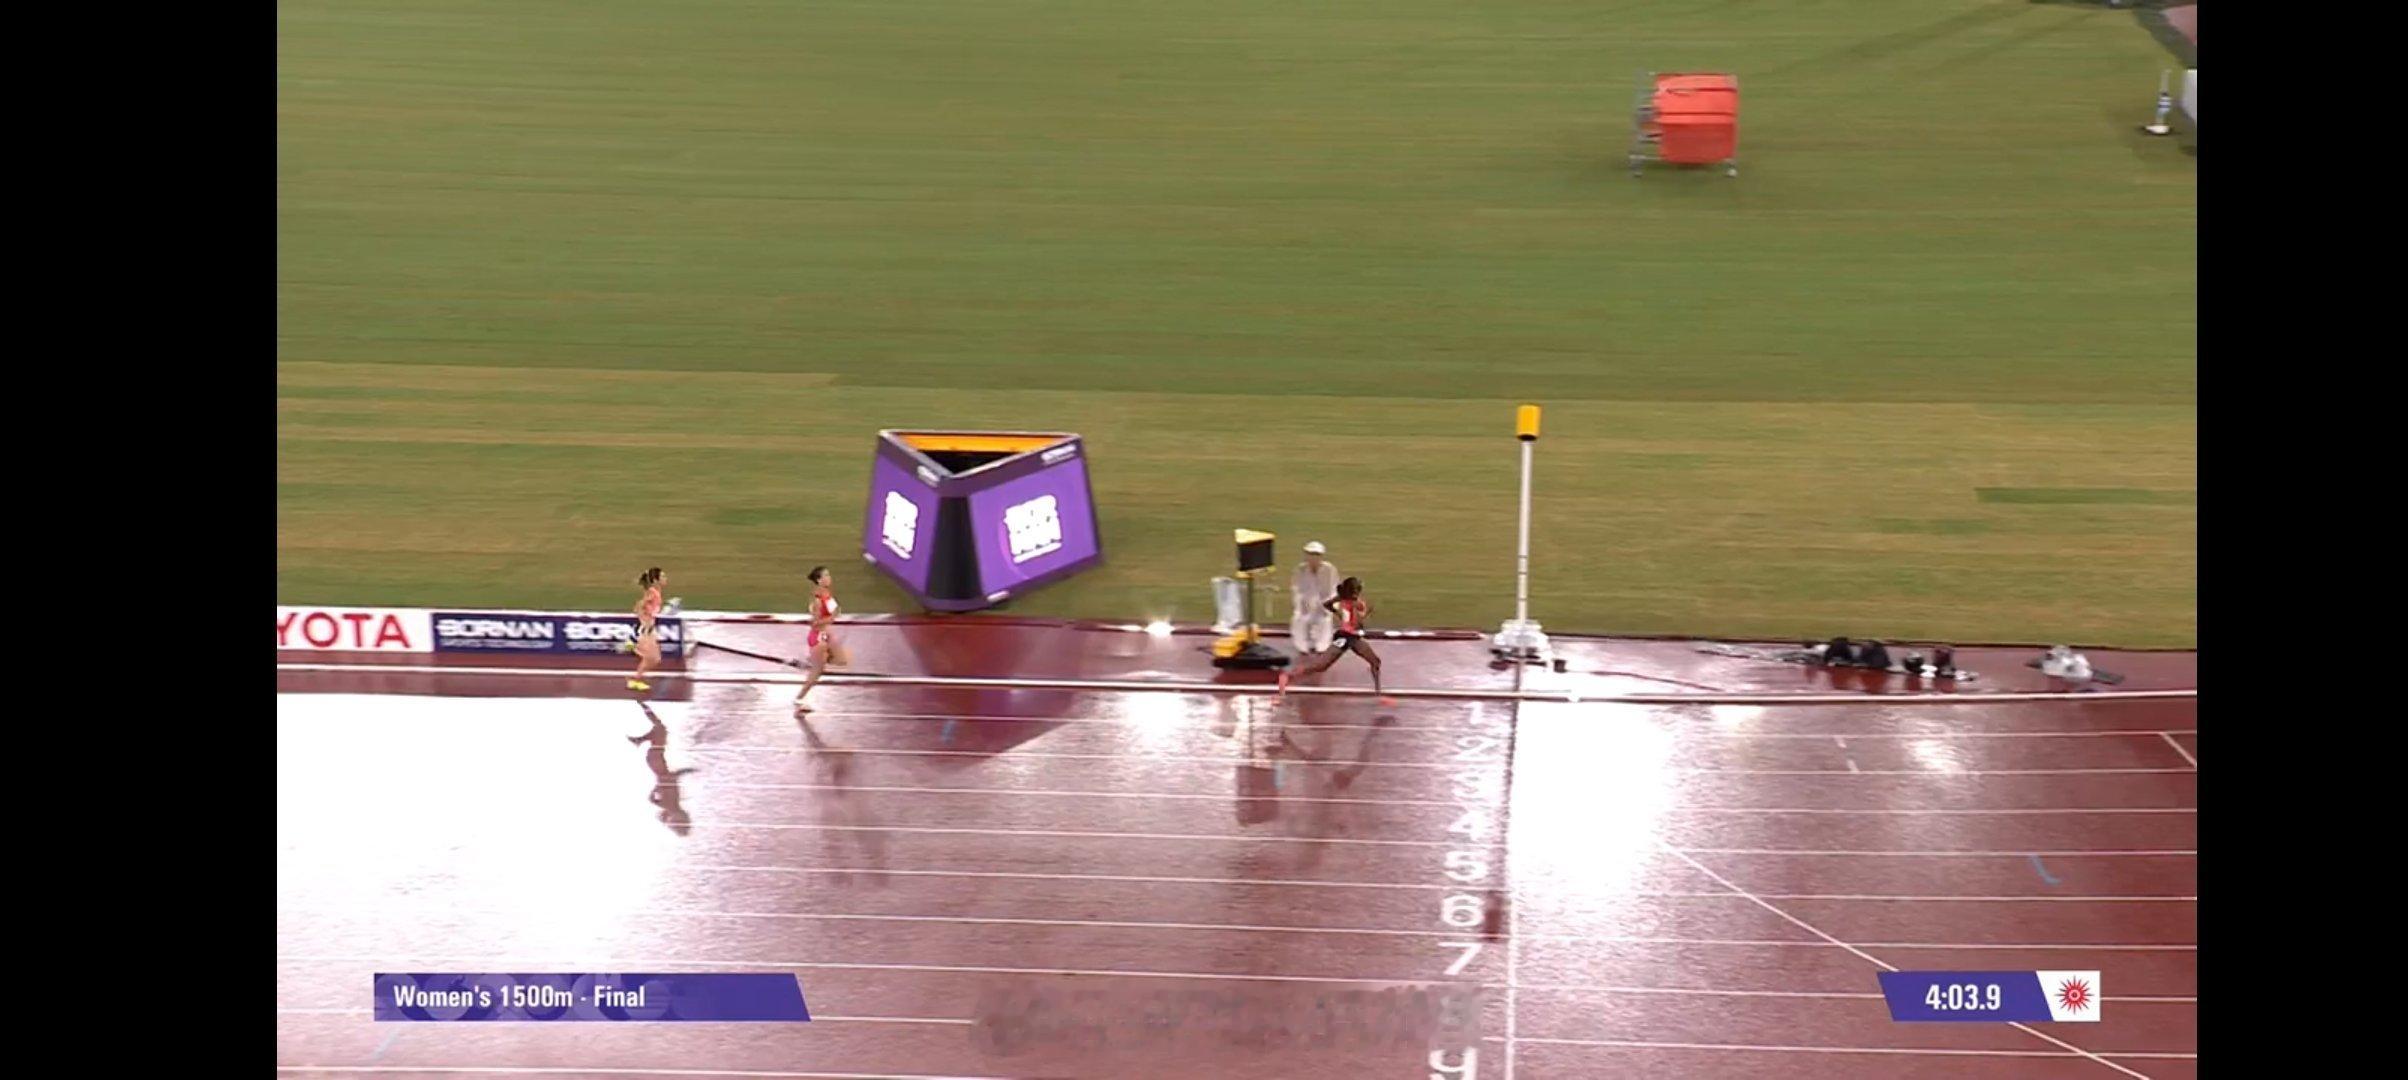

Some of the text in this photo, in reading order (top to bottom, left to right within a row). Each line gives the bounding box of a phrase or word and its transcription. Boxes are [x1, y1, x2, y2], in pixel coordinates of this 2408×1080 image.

[436, 618, 555, 639] BORNAN
[1455, 736, 1498, 761] 2
[1444, 850, 1488, 880] 5
[1441, 894, 1485, 927] 6
[1438, 941, 1483, 975] 7
